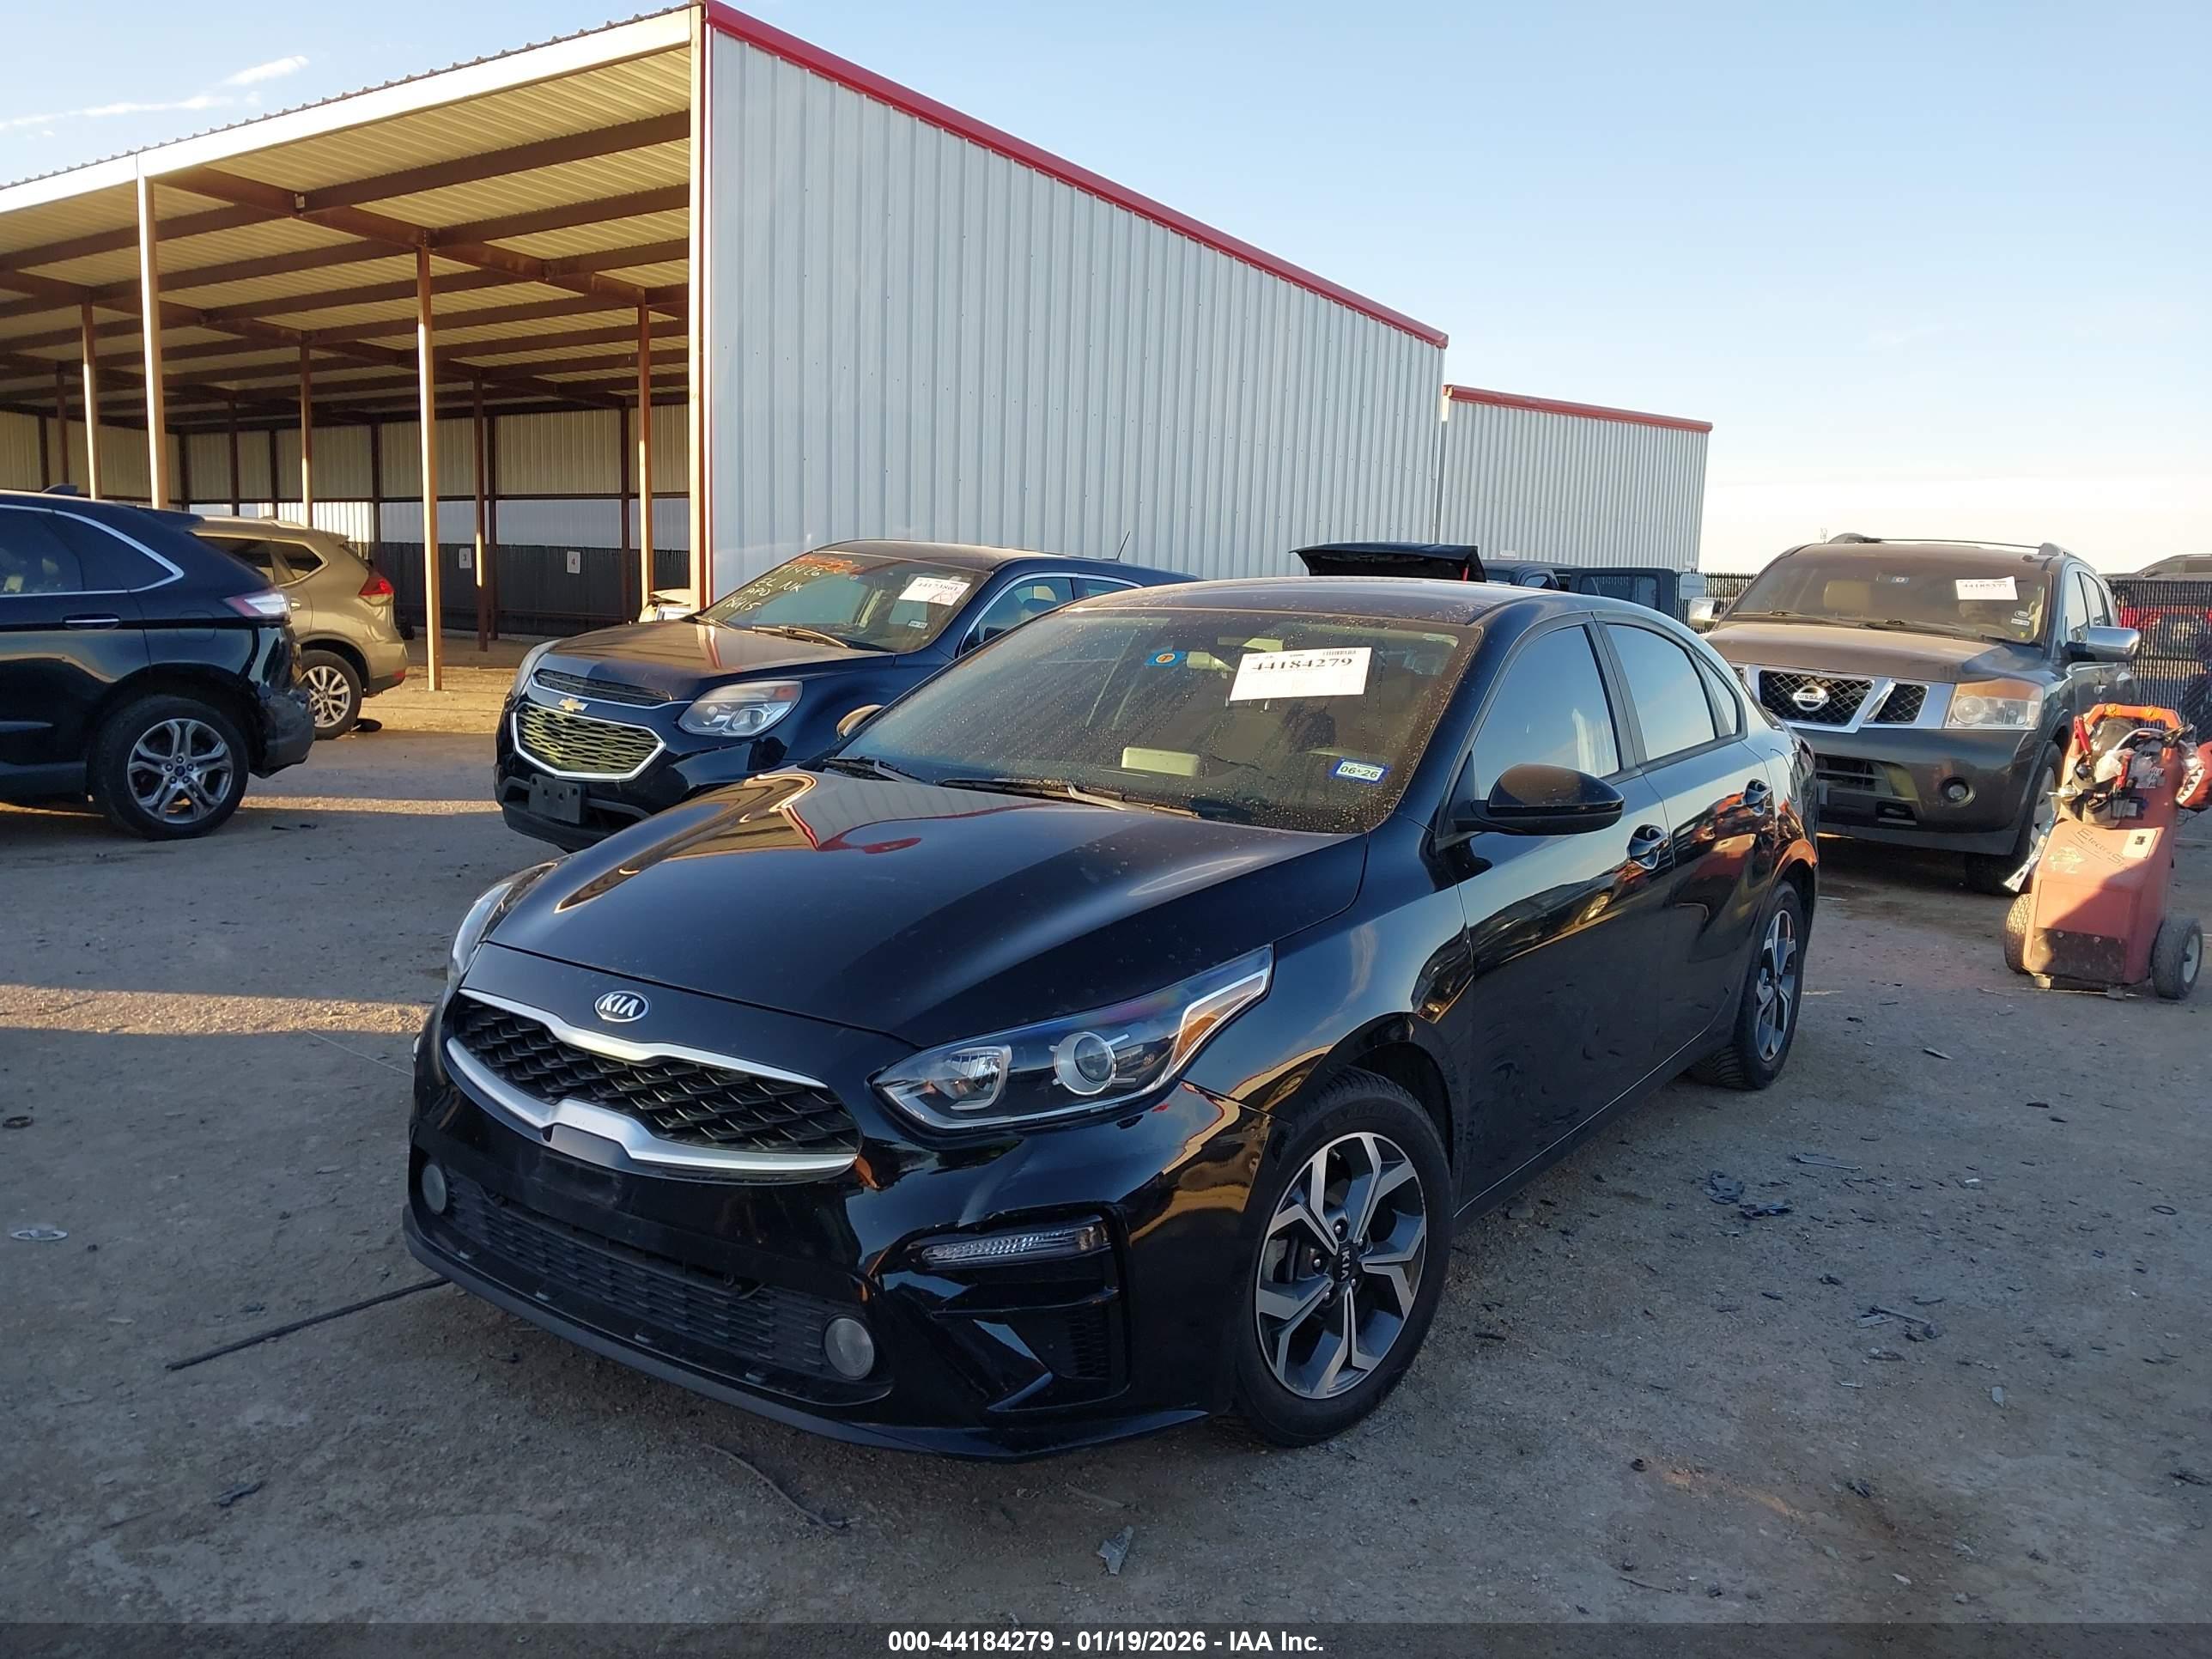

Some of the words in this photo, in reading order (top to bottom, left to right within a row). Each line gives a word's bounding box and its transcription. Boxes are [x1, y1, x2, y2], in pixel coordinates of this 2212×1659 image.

[1251, 658, 1353, 672] 44184279
[1796, 693, 1825, 702] NISSAN
[599, 994, 640, 1018] KIA
[1340, 1250, 1351, 1279] KIA
